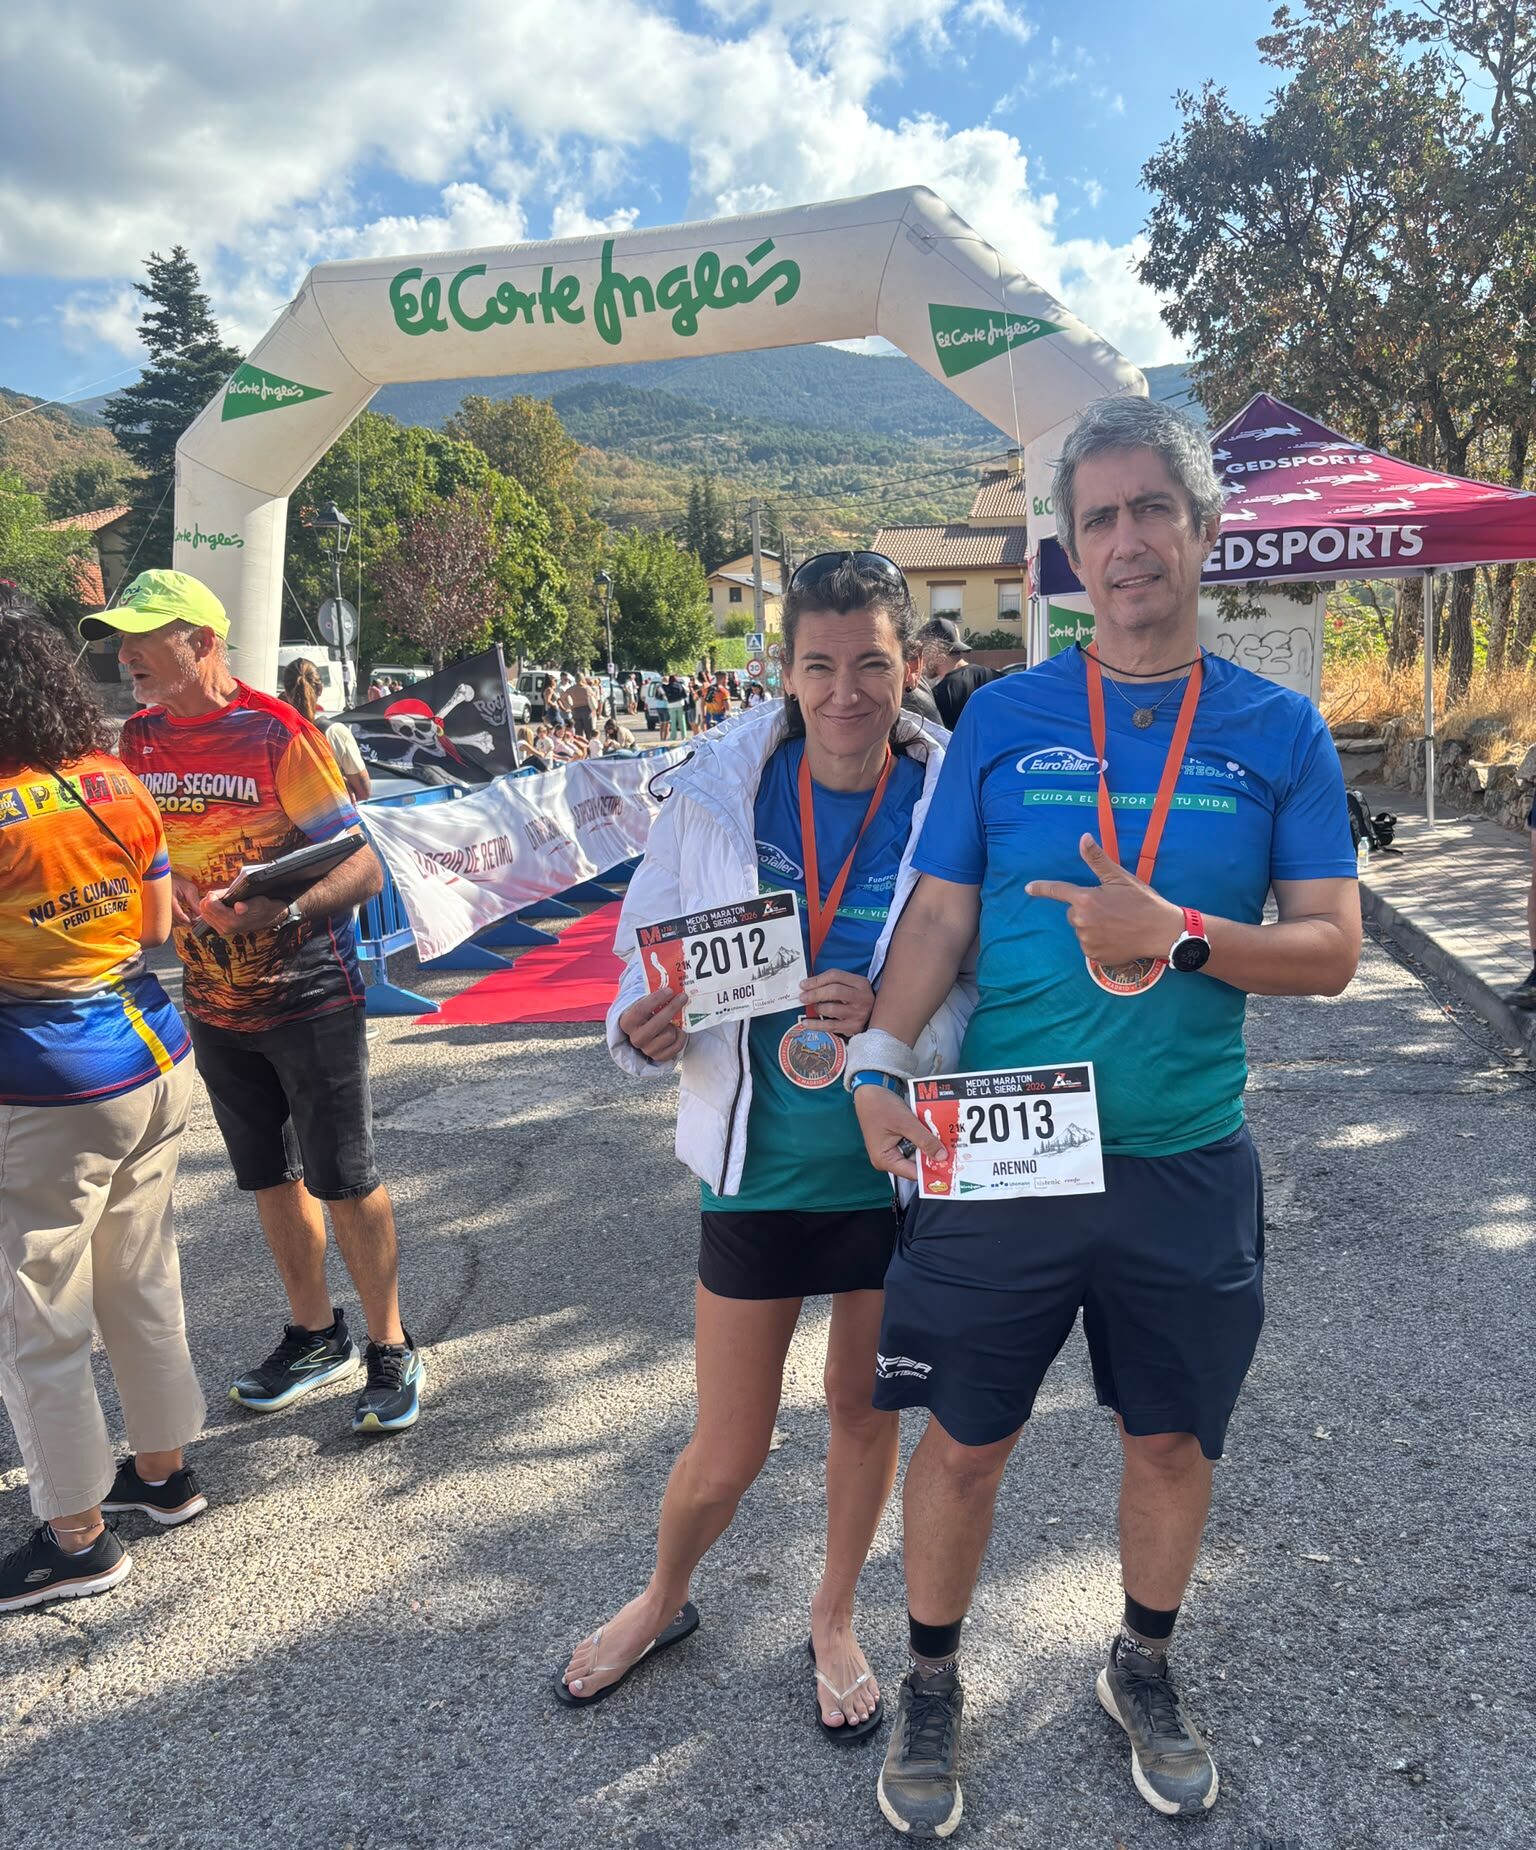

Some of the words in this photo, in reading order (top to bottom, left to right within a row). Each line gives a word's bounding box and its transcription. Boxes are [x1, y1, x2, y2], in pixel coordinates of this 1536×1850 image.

[389, 267, 448, 336] El
[448, 264, 585, 332] Corte
[594, 238, 800, 345] Inglés
[936, 331, 952, 348] El
[951, 328, 986, 346] Corte
[987, 319, 1041, 345] Inglés
[237, 382, 260, 395] Corte
[260, 378, 304, 401] Inglés
[1226, 454, 1373, 473] GEDSPORTS
[192, 523, 245, 550] Inglés
[1202, 525, 1425, 573] EDSPORTS
[1030, 758, 1095, 773] EuroTaller
[155, 796, 206, 813] 2026
[1033, 793, 1073, 802] CUIDA
[1079, 795, 1094, 803] EL
[1111, 796, 1147, 805] OTOR
[1176, 797, 1192, 805] TU
[1198, 798, 1229, 809] VIDA
[480, 834, 514, 872] RETIRO
[759, 854, 795, 874] oTaller
[29, 900, 56, 927] NO
[59, 886, 80, 912] SÉ
[63, 910, 91, 930] PERO
[94, 898, 128, 919] LLEGARÉ
[685, 914, 709, 926] MEDIO
[710, 905, 746, 922] MARATON
[688, 924, 698, 934] DE
[700, 921, 711, 931] LA
[713, 915, 738, 929] SIERRA
[739, 912, 758, 922] 2026
[690, 927, 769, 980] 2012
[675, 959, 692, 972] 21K
[716, 990, 730, 1005] LA
[732, 984, 756, 1000] ROCI
[966, 1078, 991, 1089] MEDIO
[992, 1074, 1033, 1085] MARATON
[966, 1087, 978, 1097] DE
[980, 1086, 992, 1096] LA
[995, 1082, 1023, 1095] SIERRA
[1025, 1082, 1046, 1092] 2026
[949, 1123, 966, 1134] 21K
[966, 1099, 1055, 1145] 2013
[992, 1159, 1038, 1177] ARENNO
